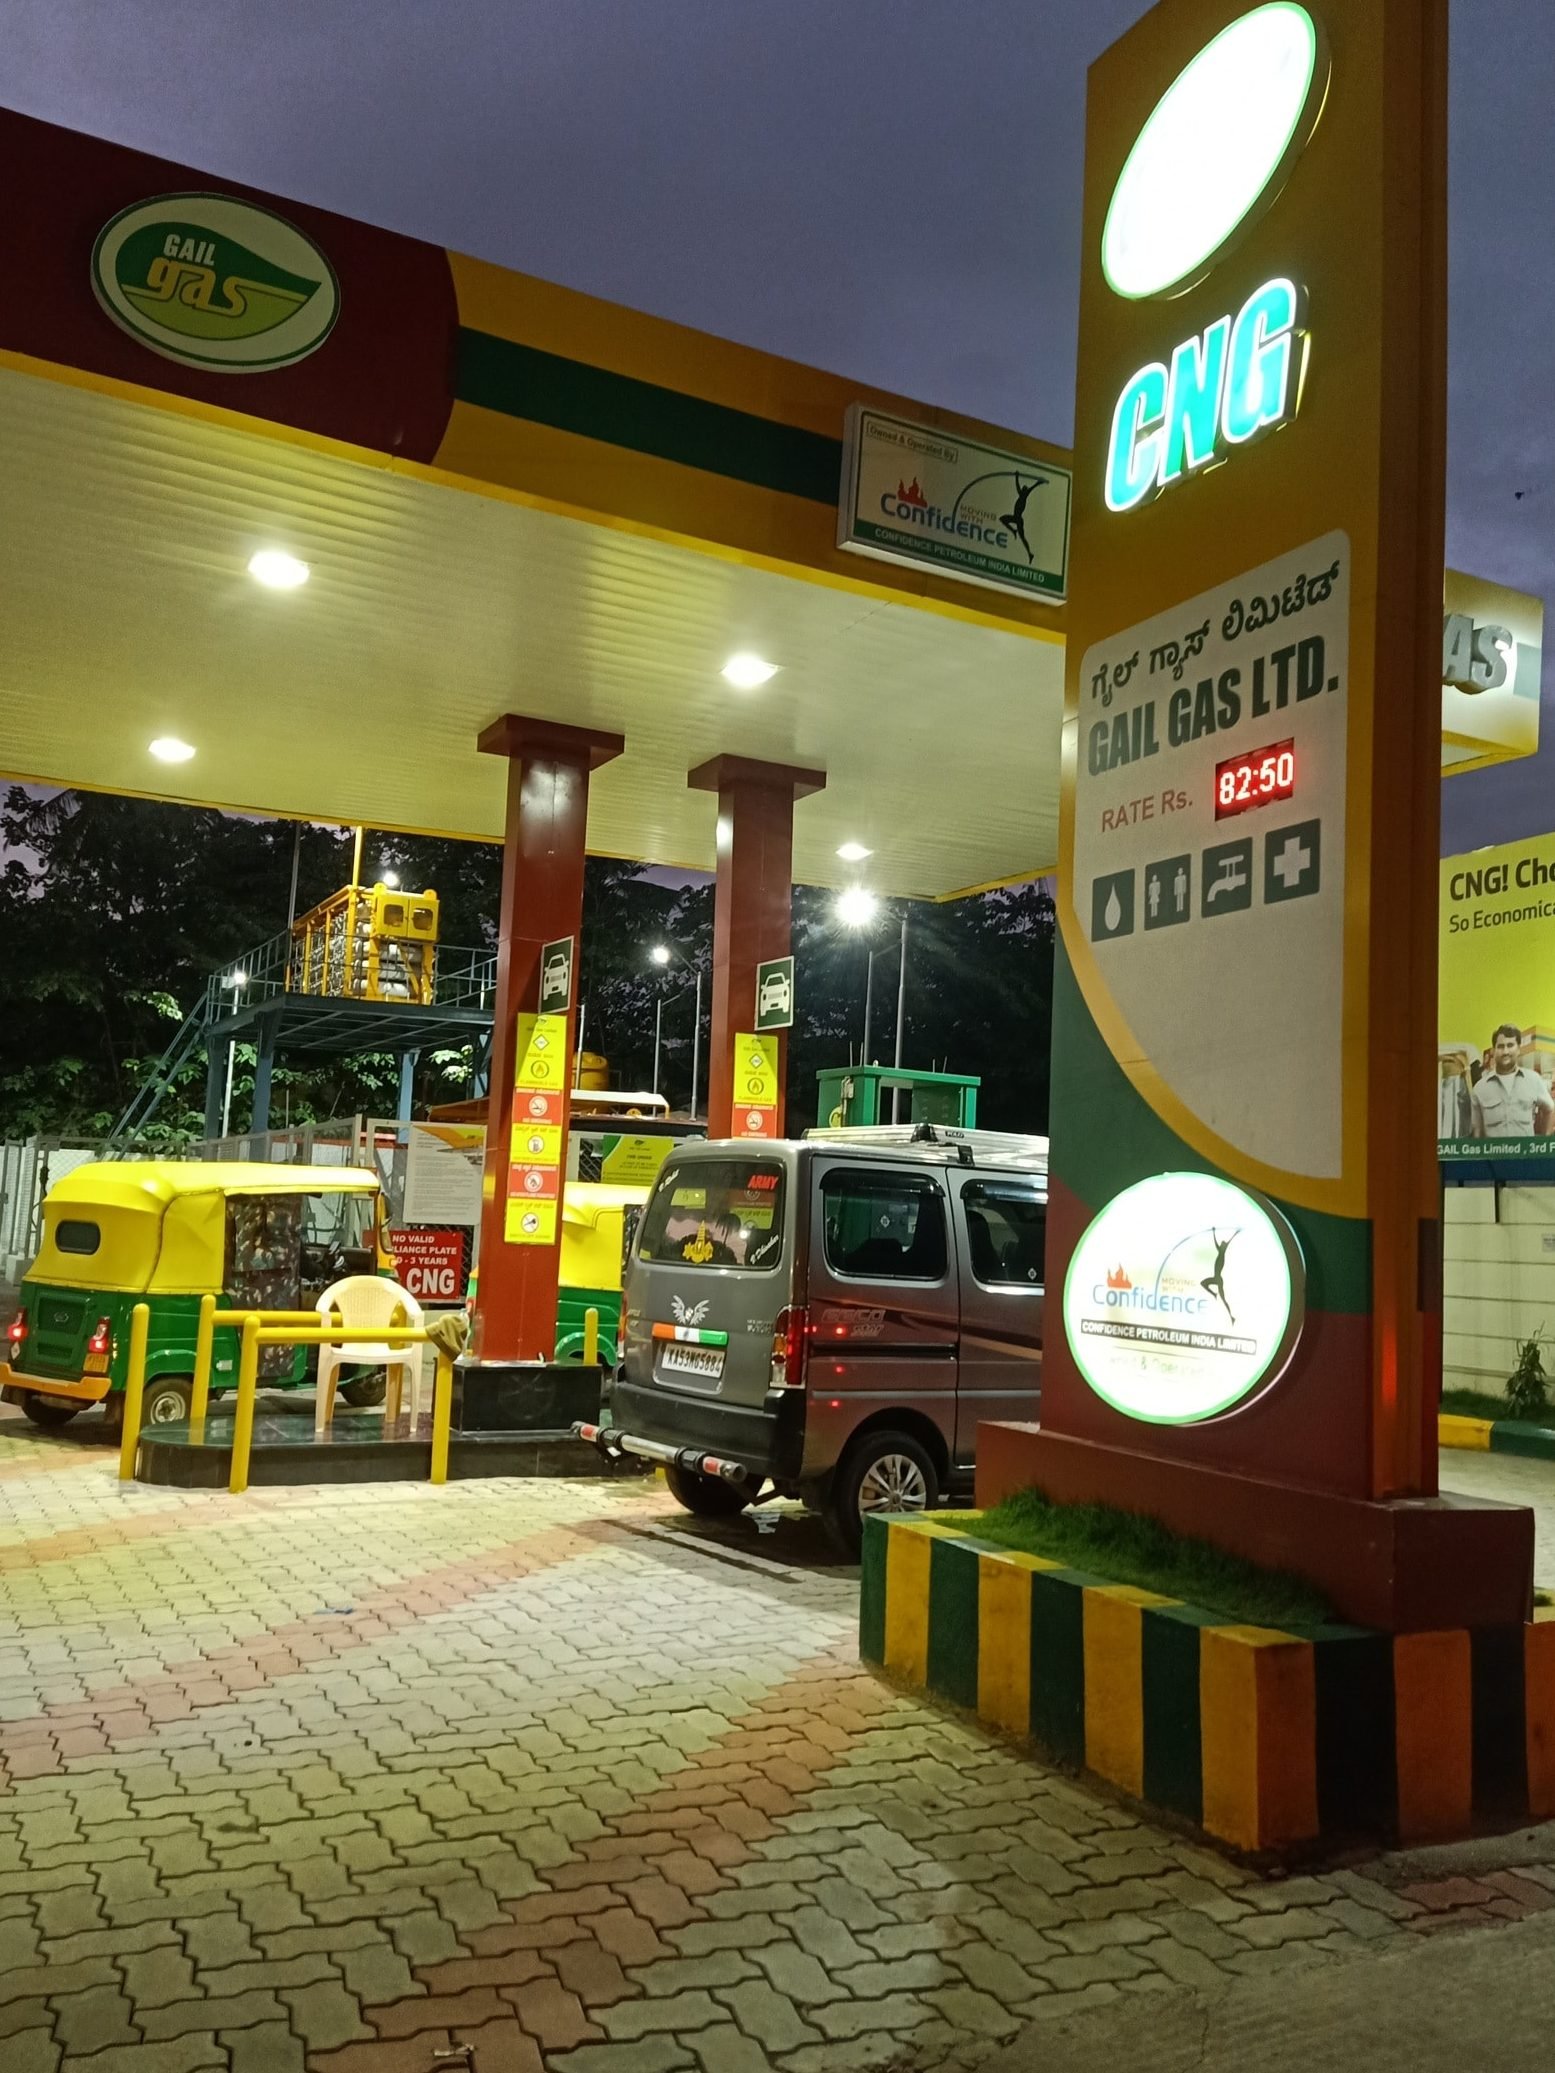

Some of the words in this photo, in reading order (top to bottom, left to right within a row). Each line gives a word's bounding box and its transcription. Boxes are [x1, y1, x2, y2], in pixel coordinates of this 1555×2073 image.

[163, 234, 216, 265] GAIL
[146, 257, 247, 318] gas
[1105, 278, 1297, 512] CNG
[881, 493, 1008, 549] Confidence
[960, 504, 997, 521] MOVING
[961, 513, 983, 524] WITH
[875, 527, 933, 549] CONFIDENCE
[935, 544, 986, 568] PETROLEUM
[988, 561, 1011, 575] INDIA
[1012, 567, 1045, 583] LIMITED
[1149, 619, 1210, 681] ಗ್ಯಾಸ್
[1222, 559, 1340, 641] ಲಿಮಿಟೆಡ್
[1442, 613, 1513, 690] AS
[1088, 700, 1160, 777] GAIL
[1168, 668, 1241, 748] GAS
[1251, 635, 1339, 719] LTD.
[1219, 752, 1295, 806] 82:50
[1102, 796, 1154, 833] RATE
[1163, 788, 1193, 812] Rs.
[1450, 864, 1508, 901] CNG!
[1449, 914, 1469, 933] So
[1473, 900, 1555, 929] Economic
[1461, 1144, 1481, 1155] Gas
[1484, 1143, 1521, 1154] Limited
[1529, 1142, 1547, 1153] 3rd
[747, 1174, 779, 1190] ARMY
[392, 1234, 406, 1242] NO
[408, 1235, 435, 1243] VALID
[392, 1246, 427, 1254] LIANCE
[410, 1256, 416, 1264] 3
[418, 1257, 448, 1265] YEARS
[406, 1267, 455, 1295] CNG
[1082, 1320, 1135, 1337] CONFIDENCE
[1136, 1328, 1189, 1345] PETROLEUM
[1191, 1335, 1216, 1348] INDIA
